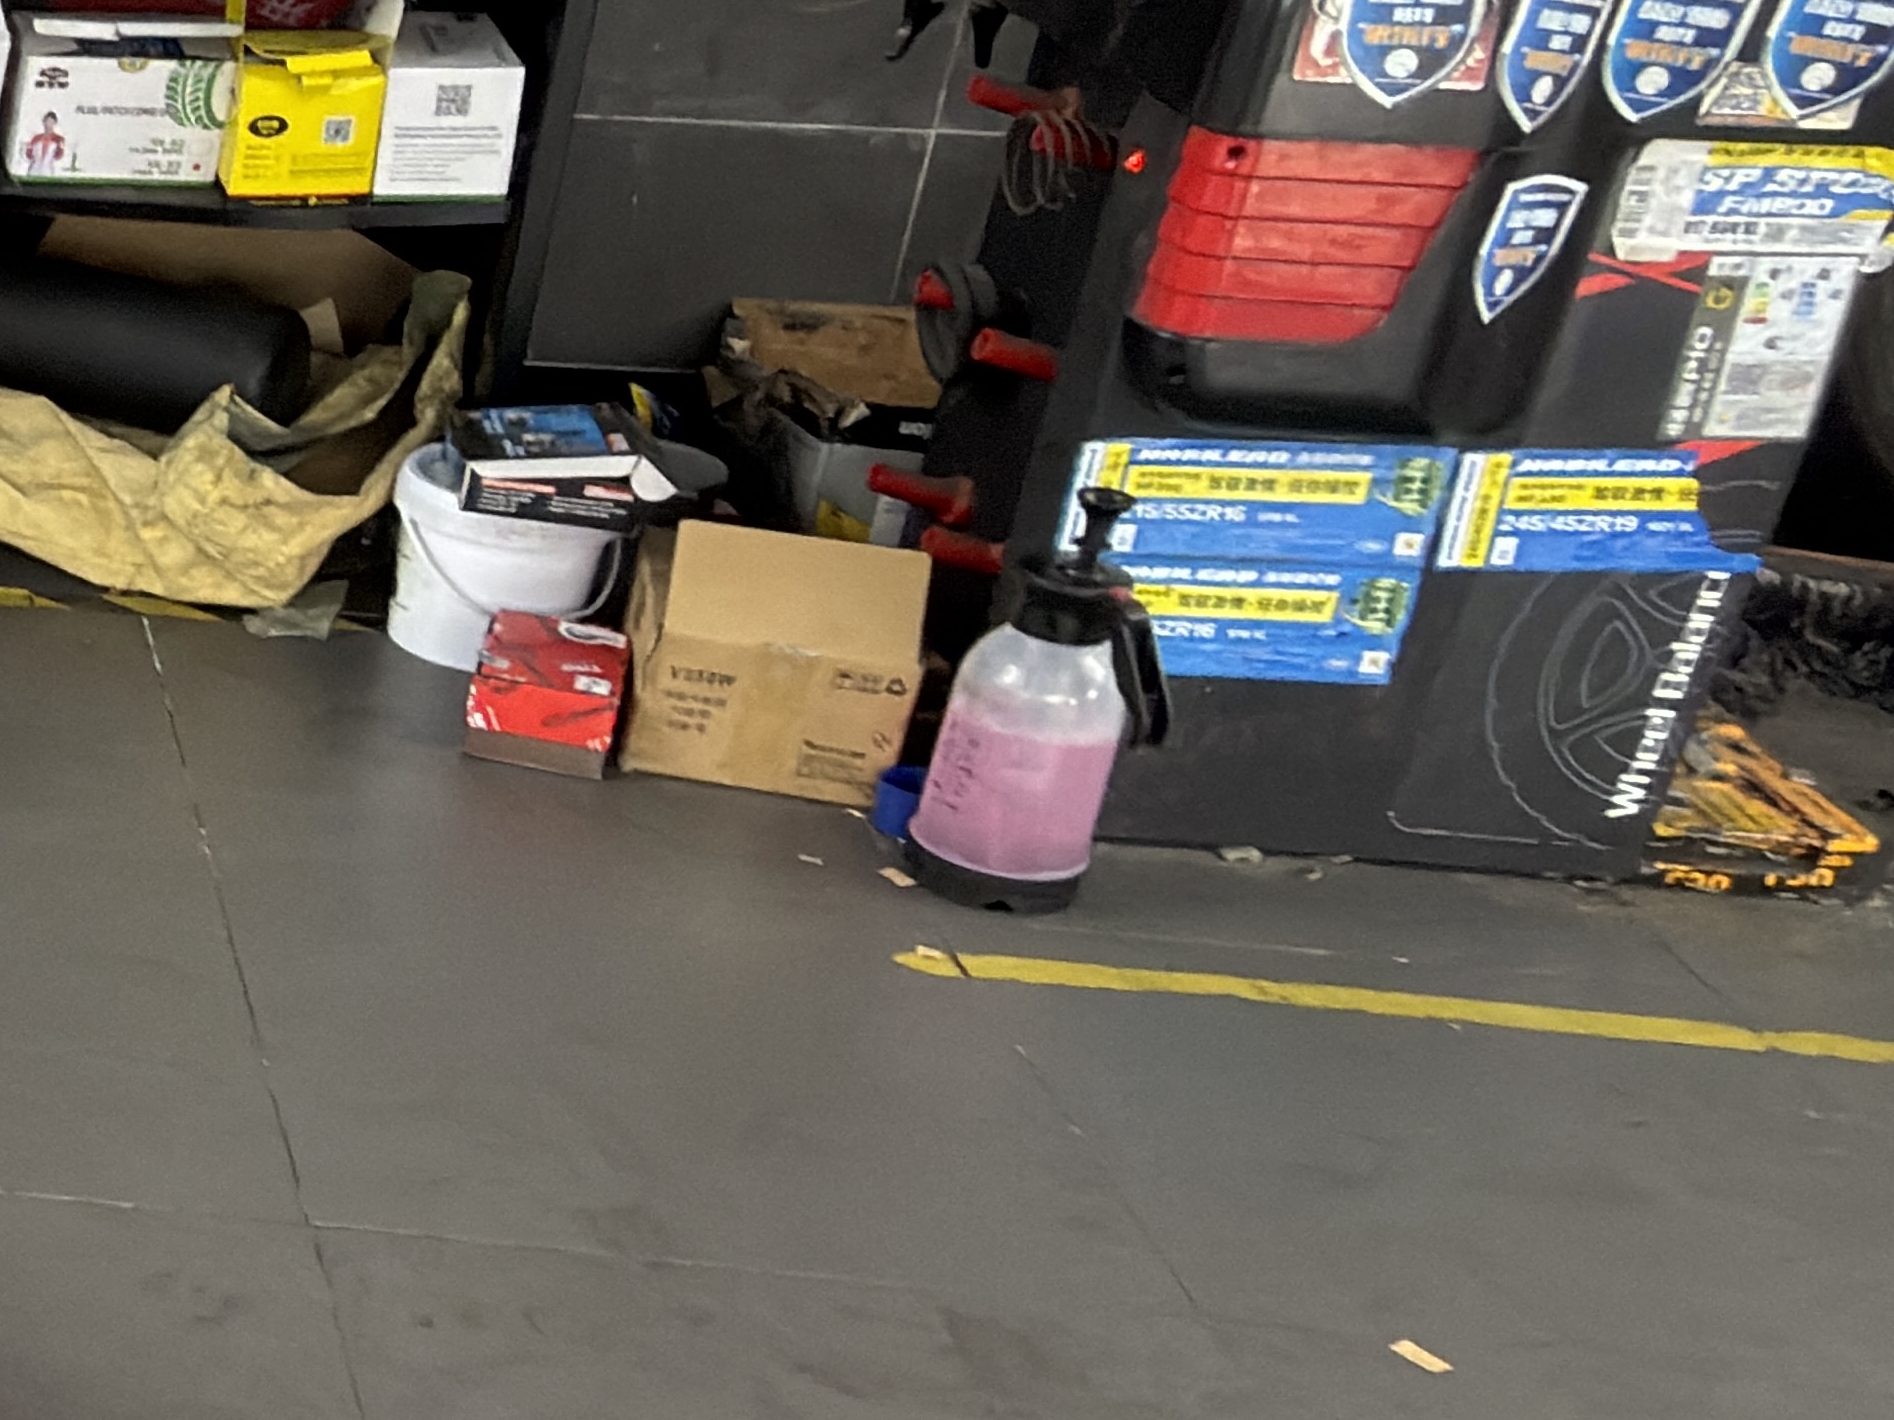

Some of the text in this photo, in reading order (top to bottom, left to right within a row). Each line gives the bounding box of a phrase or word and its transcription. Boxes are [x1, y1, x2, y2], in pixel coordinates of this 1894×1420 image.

[1700, 167, 1764, 192] SP
[1123, 502, 1248, 523] 15/55ZR16
[1603, 708, 1677, 818] Wheel
